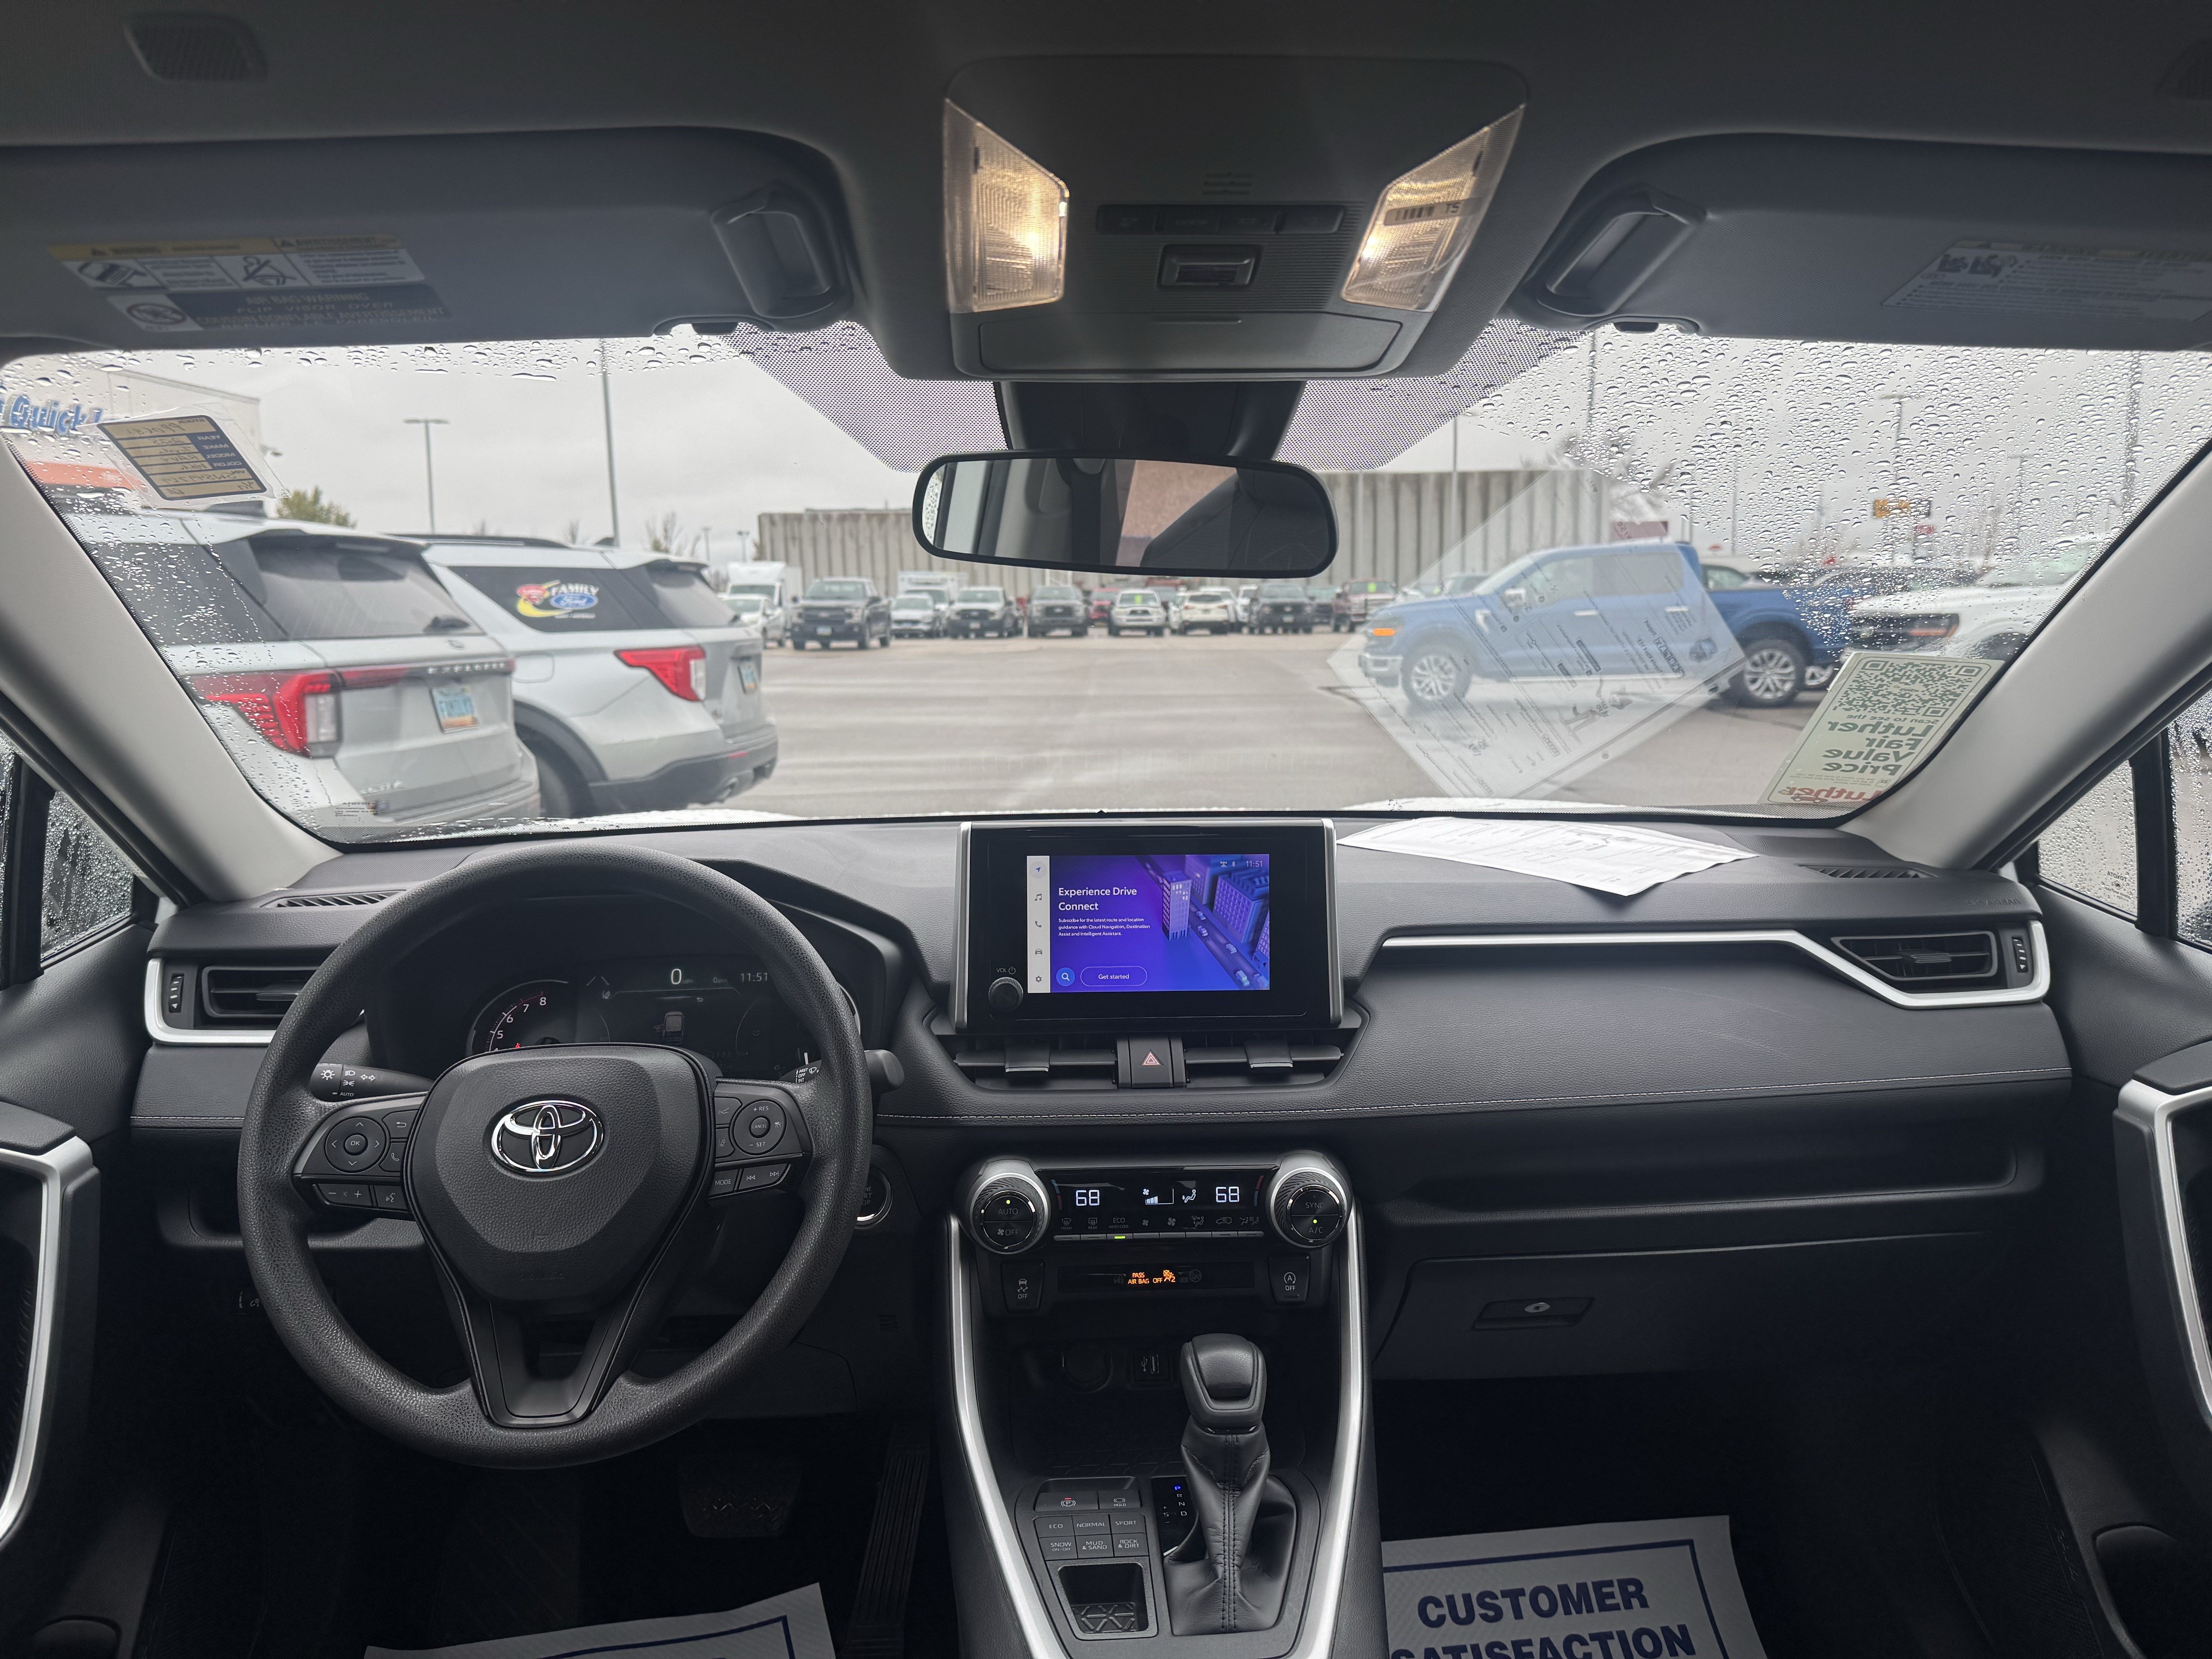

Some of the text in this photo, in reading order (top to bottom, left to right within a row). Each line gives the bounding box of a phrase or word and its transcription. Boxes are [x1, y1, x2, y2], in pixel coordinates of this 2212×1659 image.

[9, 393, 88, 434] Quick
[551, 583, 599, 596] FAMILY
[1058, 887, 1137, 897] Experience Drive
[1058, 902, 1099, 910] Connect
[671, 968, 682, 985] 0
[740, 972, 768, 982] 11:51
[539, 997, 546, 1005] 8
[523, 1004, 529, 1012] 7
[507, 1014, 514, 1023] 6
[497, 1030, 503, 1039] 5
[1075, 1190, 1100, 1206] 68
[1216, 1186, 1240, 1203] 68
[1417, 1577, 1650, 1628] CUSTOMER
